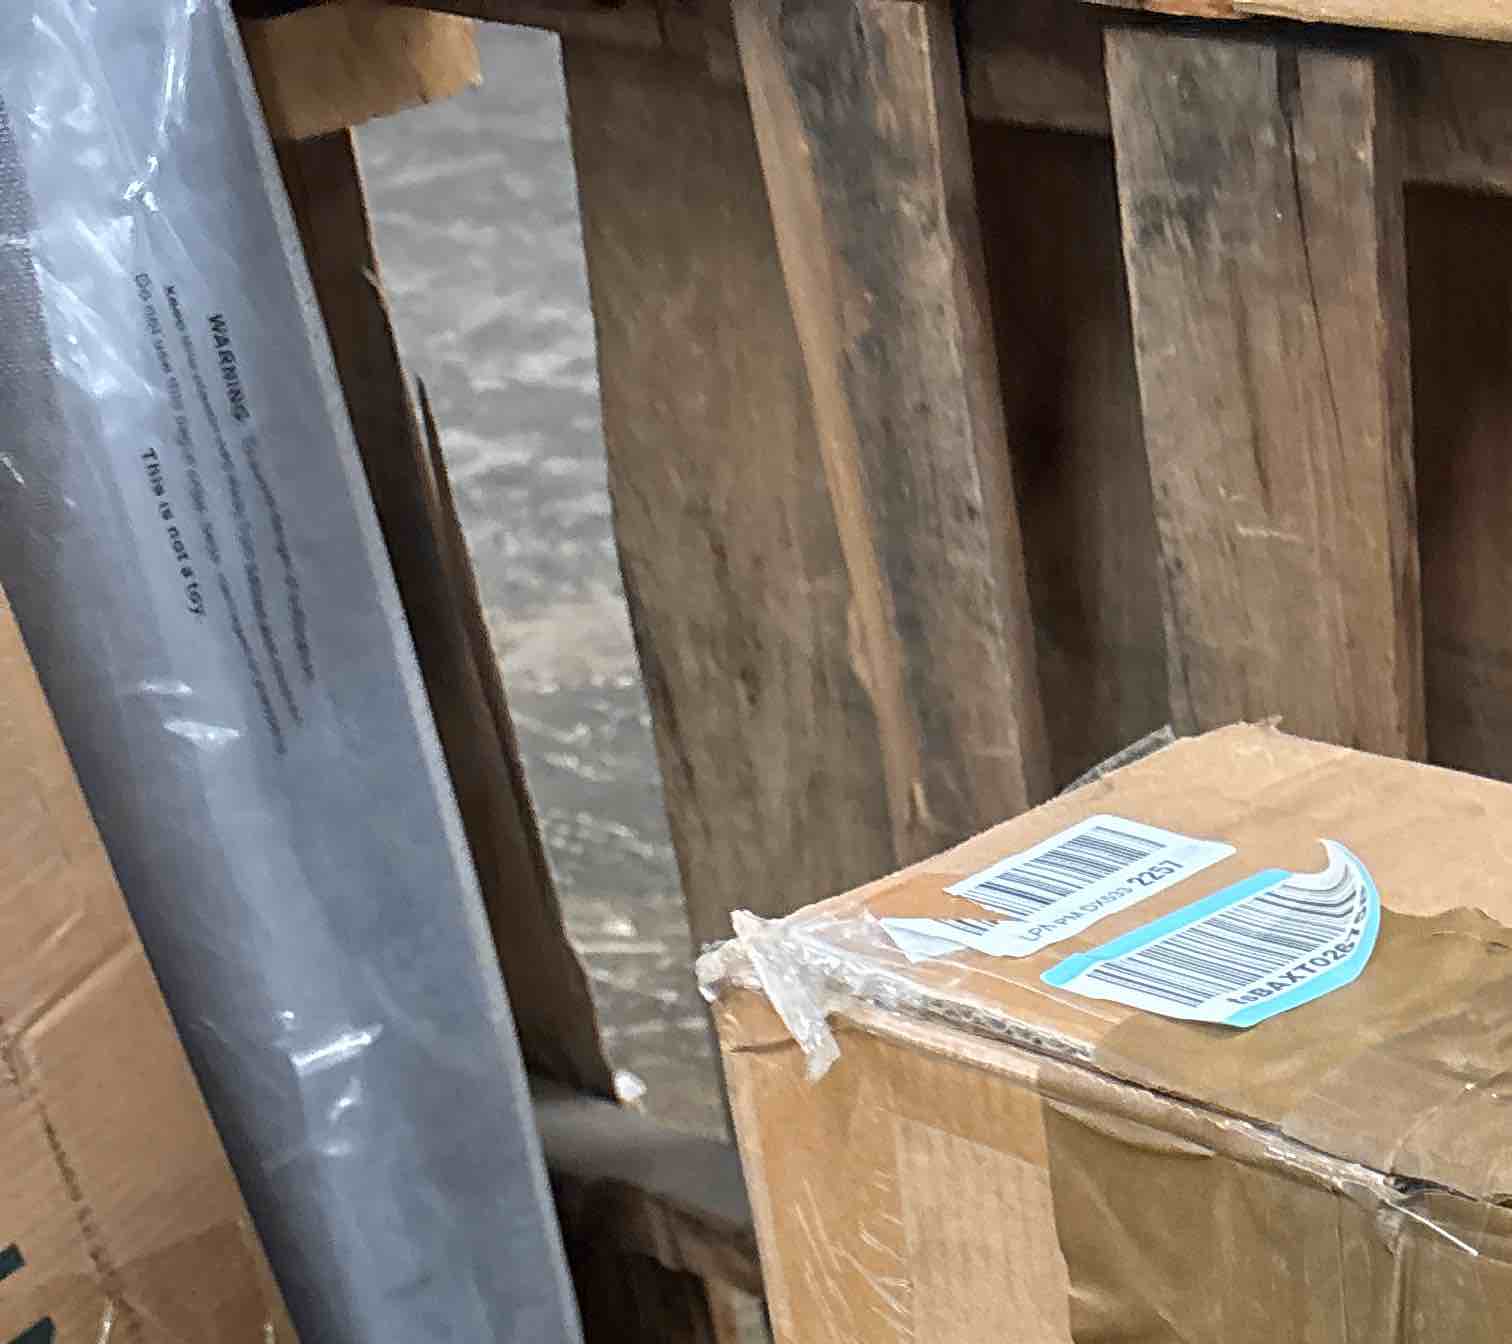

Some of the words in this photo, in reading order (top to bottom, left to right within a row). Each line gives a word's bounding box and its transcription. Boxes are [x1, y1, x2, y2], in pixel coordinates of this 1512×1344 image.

[208, 313, 250, 423] WARNING
[141, 447, 166, 497] This
[167, 524, 190, 563] not
